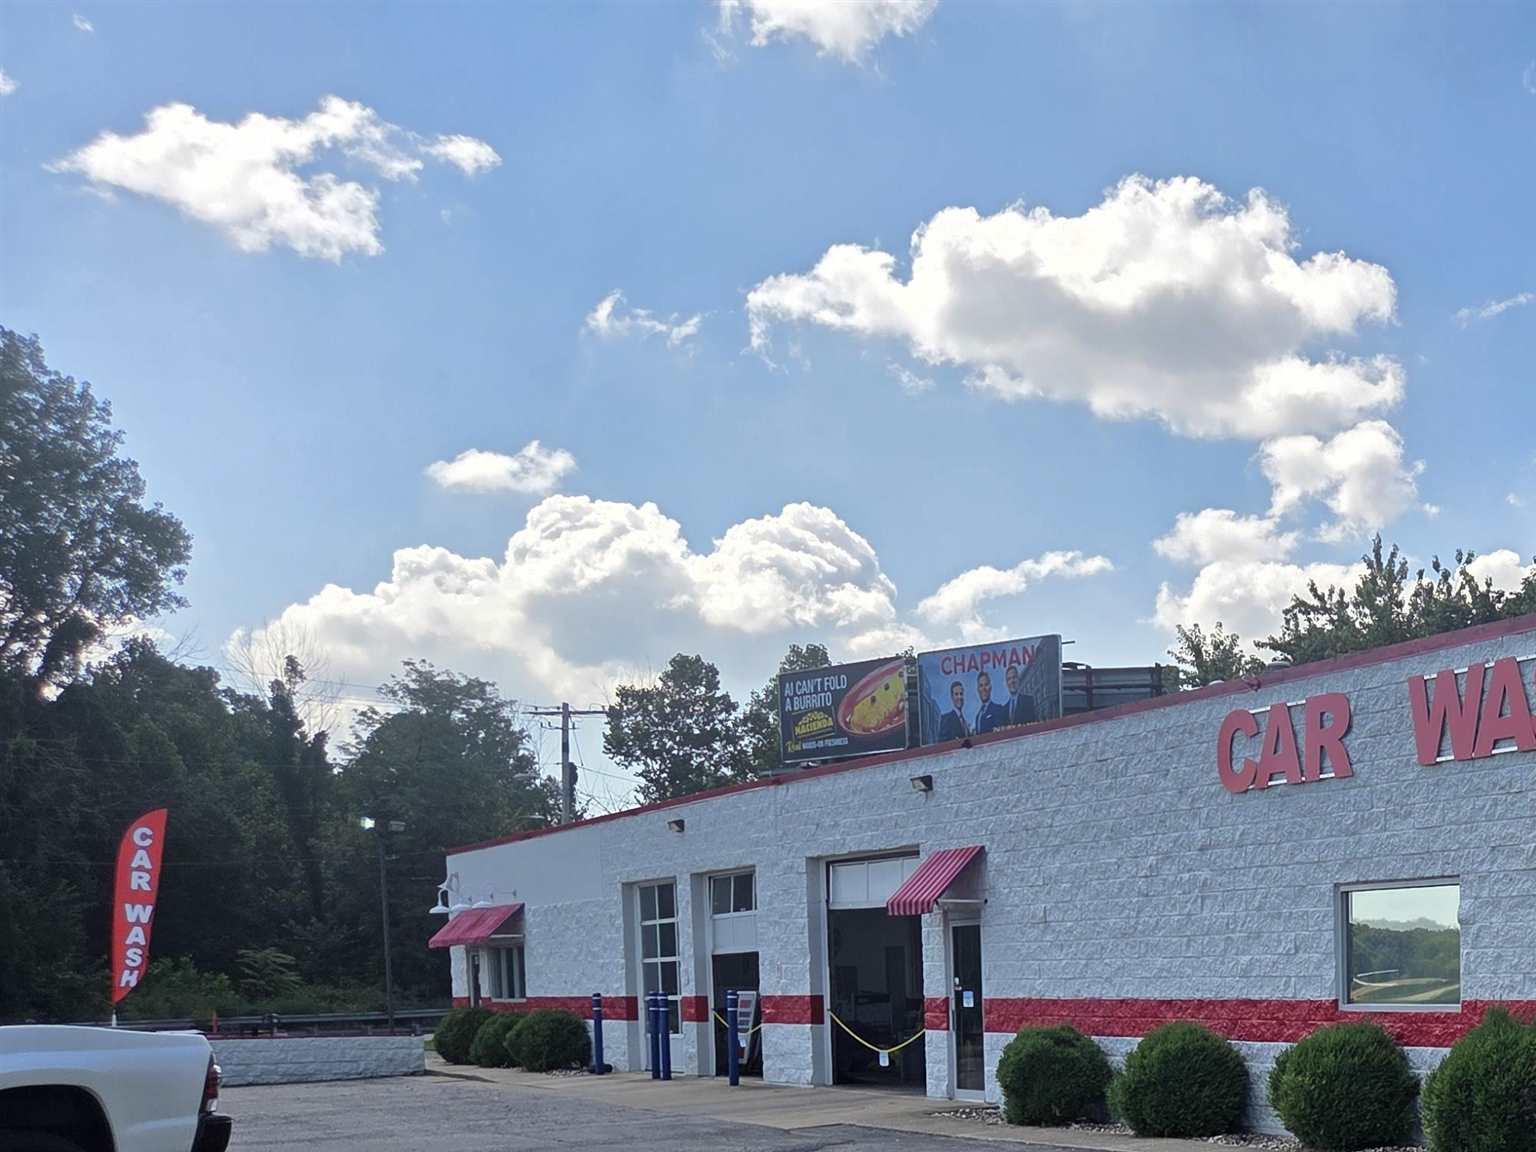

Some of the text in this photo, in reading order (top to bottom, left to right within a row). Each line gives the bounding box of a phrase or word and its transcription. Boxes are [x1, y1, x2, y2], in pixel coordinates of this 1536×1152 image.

[940, 645, 1037, 676] CHAPMAN
[796, 677, 822, 695] CAN'T
[785, 692, 832, 712] A BURRITO
[1217, 692, 1354, 793] CAR
[120, 827, 153, 988] CAR WASH
